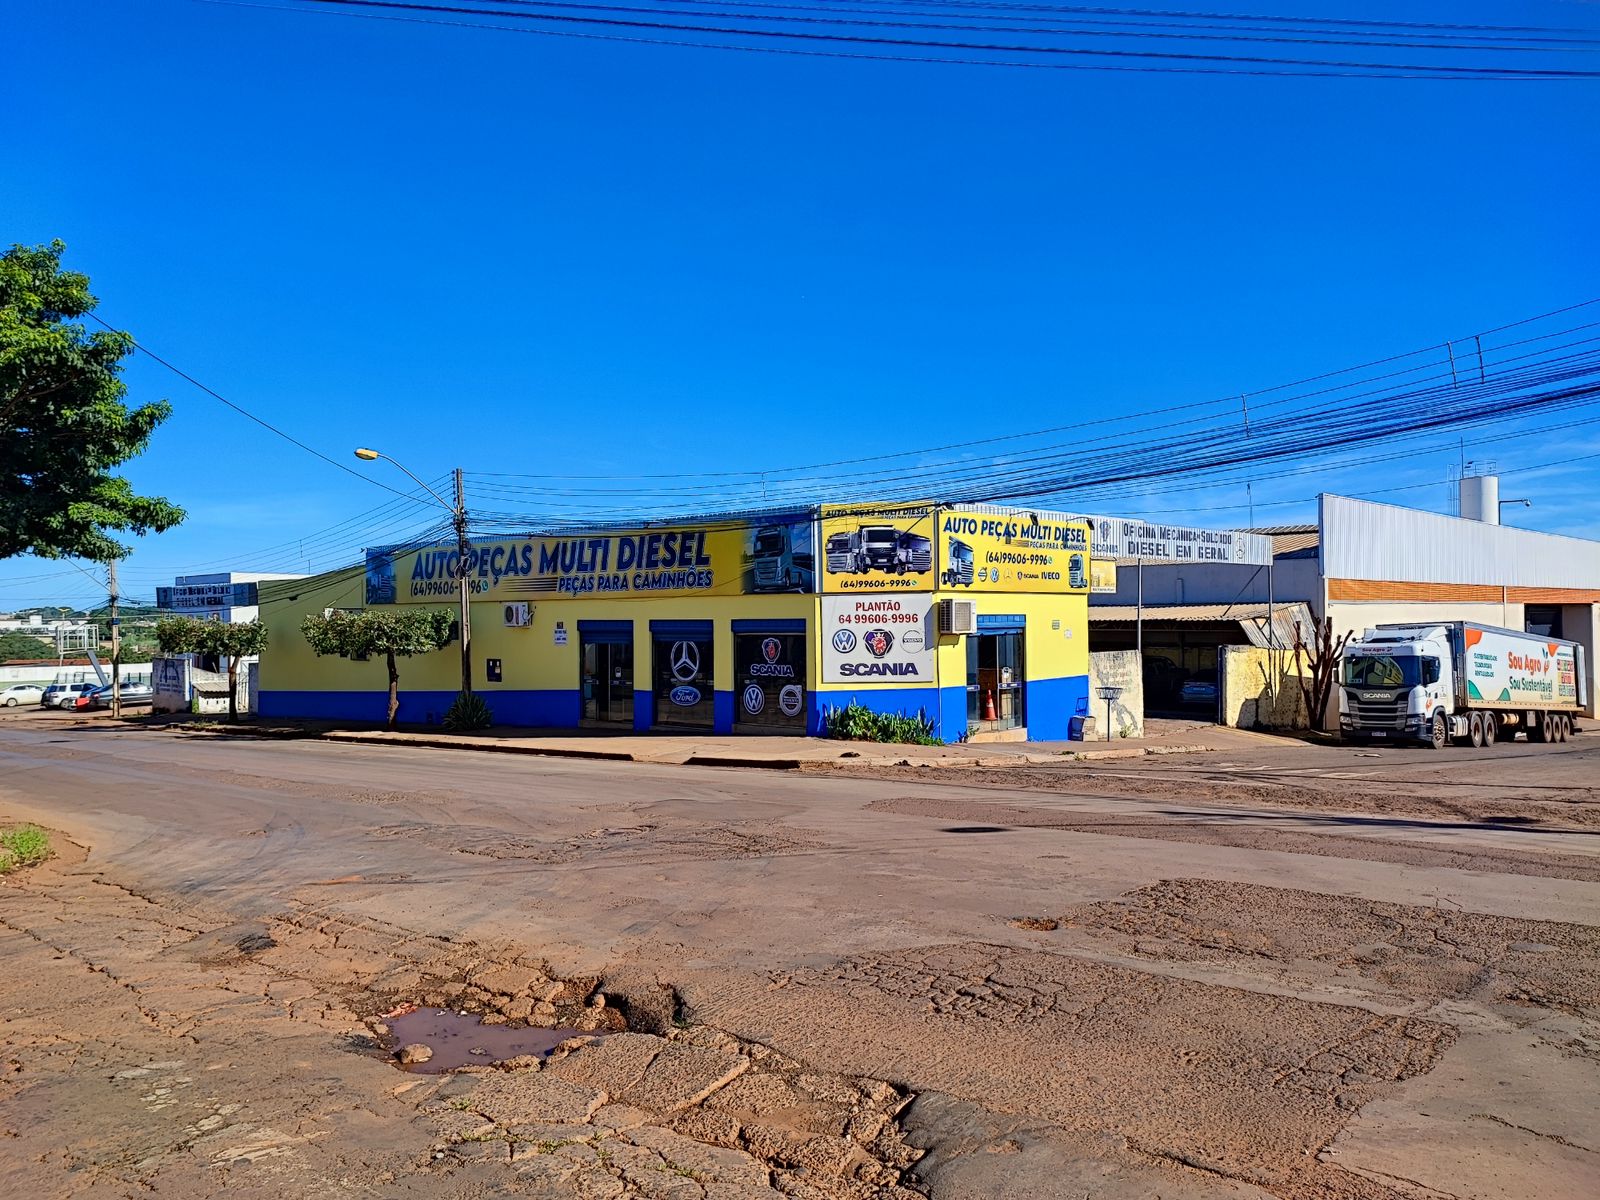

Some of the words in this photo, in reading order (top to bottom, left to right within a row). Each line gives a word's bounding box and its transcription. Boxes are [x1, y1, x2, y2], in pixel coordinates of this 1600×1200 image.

[902, 507, 929, 516] DIESEL
[943, 517, 977, 534] AUTO
[981, 519, 1017, 541] PEÇAS
[1020, 525, 1051, 541] MULTI
[1054, 526, 1086, 543] DIESEL
[538, 537, 610, 575] MULTI
[615, 529, 711, 572] DIESEL
[985, 551, 1047, 566] (64)99606-9996
[1128, 541, 1169, 557] DIESEL
[1198, 546, 1228, 561] GERAL
[558, 576, 594, 597] PEÇAS
[598, 574, 629, 593] PARA
[632, 566, 714, 590] CAMINHÕES
[1041, 572, 1060, 580] IVECO
[410, 580, 481, 598] (64)99606-96
[840, 580, 911, 589] (64)99606-9996
[855, 599, 901, 612] PLANTÃO
[838, 614, 852, 624] 64
[854, 613, 919, 624] 99606-9996
[750, 664, 794, 677] SCANIA
[840, 662, 919, 677] SCANIA
[1508, 652, 1523, 670] Sou
[1524, 655, 1541, 675] Agro
[1509, 676, 1521, 690] Sou
[1522, 677, 1552, 693] Sustentável
[674, 690, 695, 702] Ford
